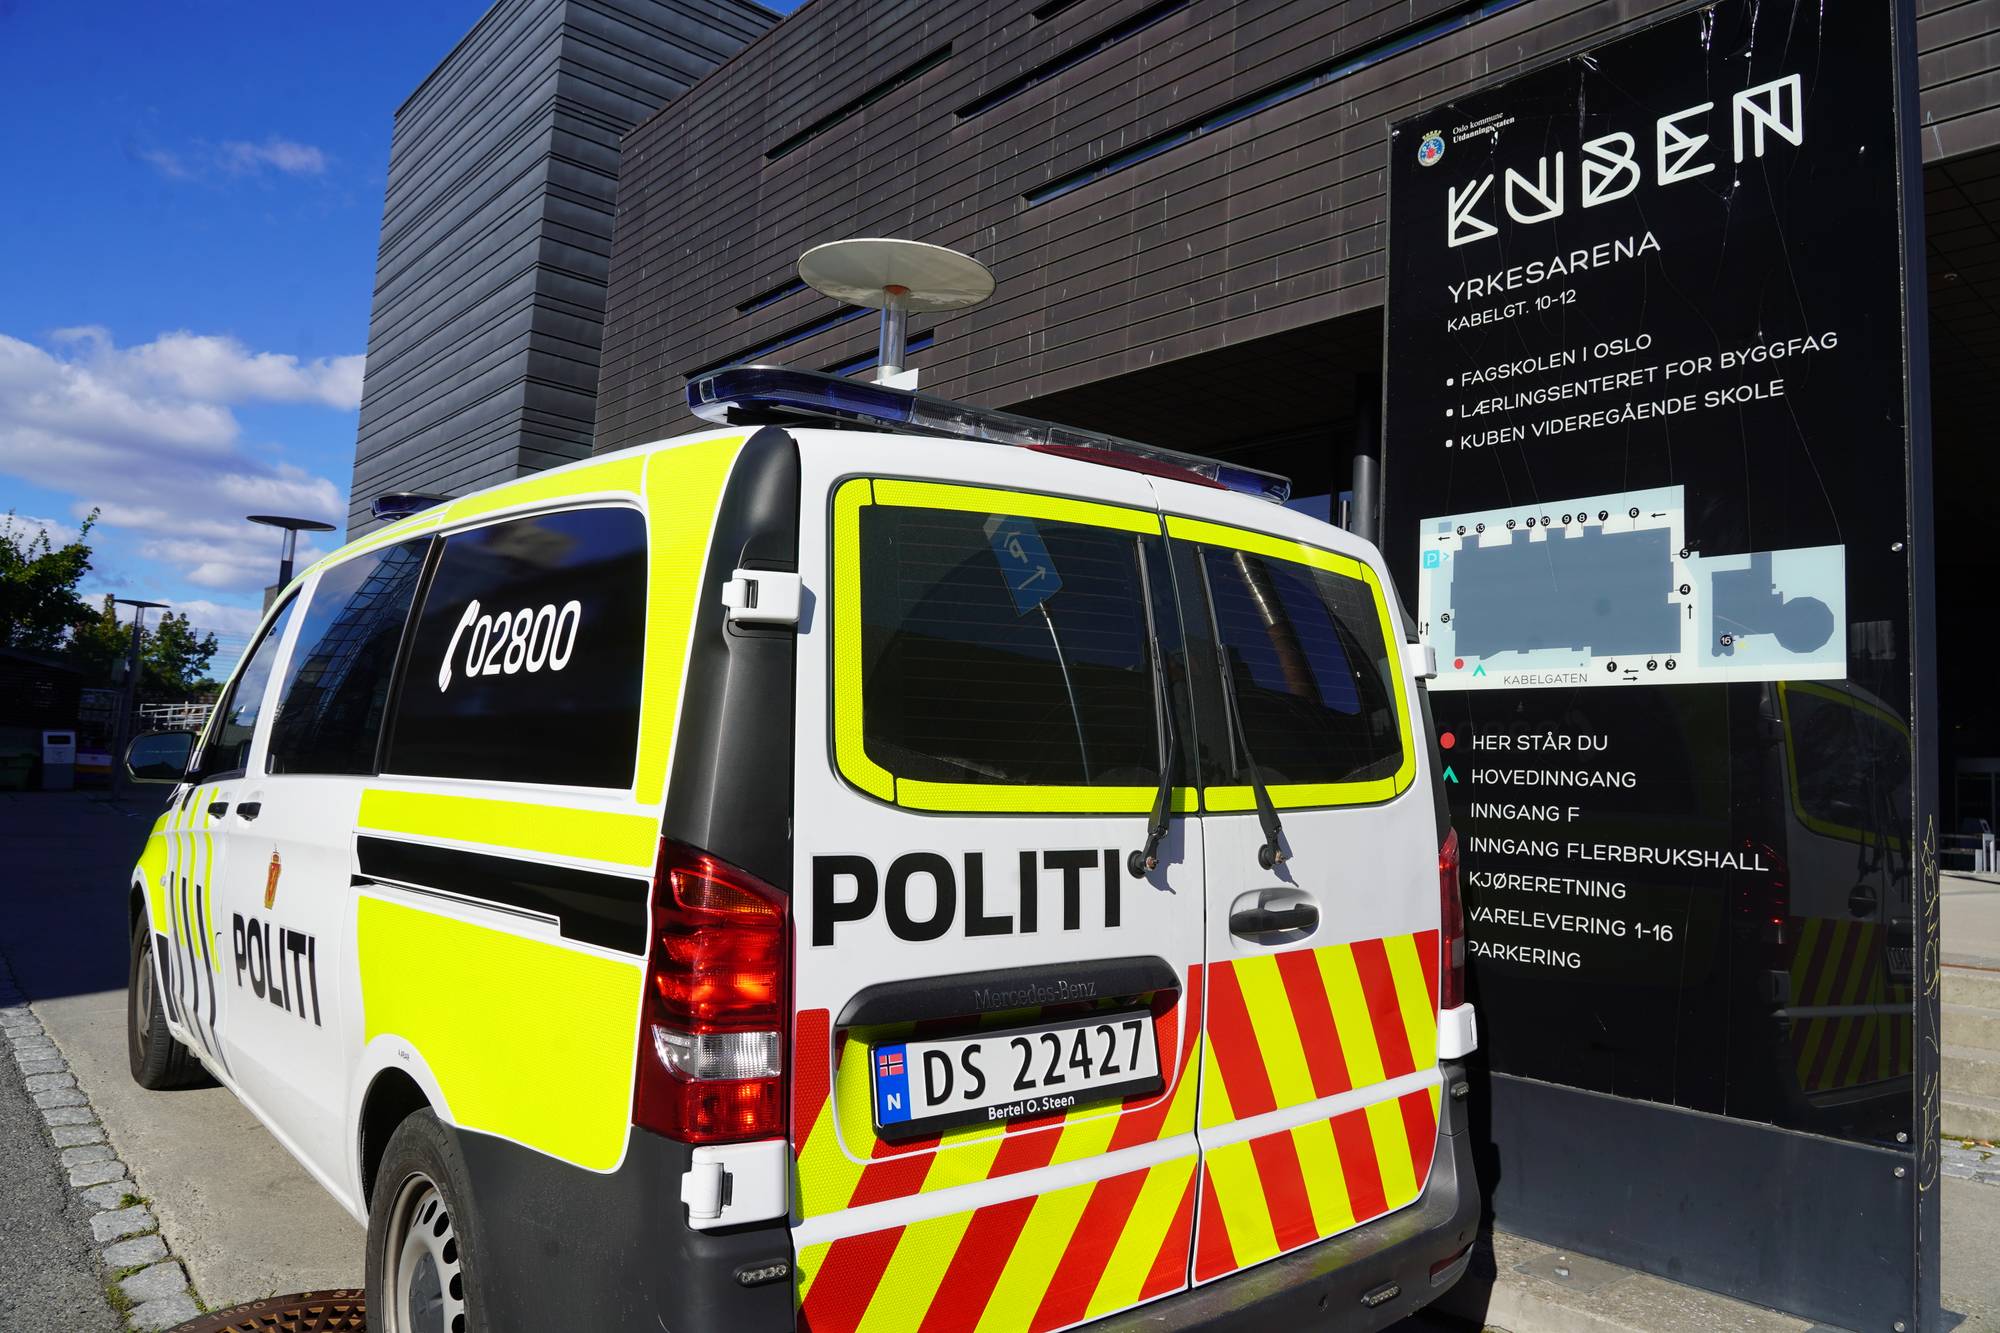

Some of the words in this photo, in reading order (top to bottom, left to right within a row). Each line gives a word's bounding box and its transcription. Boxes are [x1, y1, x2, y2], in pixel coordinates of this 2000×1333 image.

[1452, 124, 1469, 135] Oslo
[1469, 112, 1504, 129] kommune
[1448, 74, 1803, 248] KUBEN
[1447, 231, 1661, 304] YRKESARENA
[1447, 300, 1530, 333] KABELGT.
[1534, 288, 1577, 312] 10-12
[1461, 349, 1576, 388] FAGSKOLEN
[1583, 346, 1588, 362] I
[1593, 333, 1652, 360] OSLO
[1461, 366, 1659, 419] LÆRLINGSENTERET
[1665, 356, 1712, 380] FOR
[1720, 331, 1839, 369] BYGGFAG
[1460, 425, 1525, 451] KUBEN
[1531, 395, 1697, 437] VIDEREGÅENDE
[1704, 378, 1785, 408] SKOLE
[1526, 518, 1535, 526] 11
[1540, 516, 1550, 525] 10
[1562, 514, 1571, 524] 9
[1578, 513, 1586, 522] 8
[1599, 511, 1607, 520] 7
[1630, 508, 1638, 517] 6
[1457, 526, 1466, 534] 14
[1476, 524, 1485, 533] 13
[1506, 520, 1515, 529] 12
[1680, 548, 1689, 558] 5
[1680, 585, 1689, 594] 4
[1441, 614, 1449, 623] 15
[465, 600, 582, 678] 02800
[1720, 636, 1732, 645] 16
[1648, 661, 1656, 670] 2
[1666, 660, 1675, 669] 3
[1503, 673, 1588, 686] KABELGATEN
[1472, 735, 1511, 751] HER
[1516, 731, 1572, 751] STÅR
[1577, 735, 1609, 751] DU
[1471, 768, 1637, 788] HOVEDINNGANG
[1470, 802, 1560, 822] INNGANG
[1567, 806, 1581, 823] F
[1470, 836, 1560, 858] INNGANG
[1567, 843, 1769, 872] FLERBRUKSHALL
[1469, 871, 1627, 900] KJØRERETNING
[811, 848, 1121, 948] POLITI
[1468, 906, 1626, 937] VARELEVERING
[1634, 922, 1675, 942] 1-16
[1468, 940, 1581, 969] PARKERING
[232, 912, 322, 1028] POLITI
[974, 980, 1097, 1010] Mercedes-Benz
[922, 1044, 987, 1107] DS
[1010, 1019, 1143, 1092] 22427
[886, 1093, 902, 1112] N
[988, 1101, 1024, 1121] Bertel
[1026, 1099, 1041, 1113] O.
[1042, 1095, 1075, 1111] Steen
